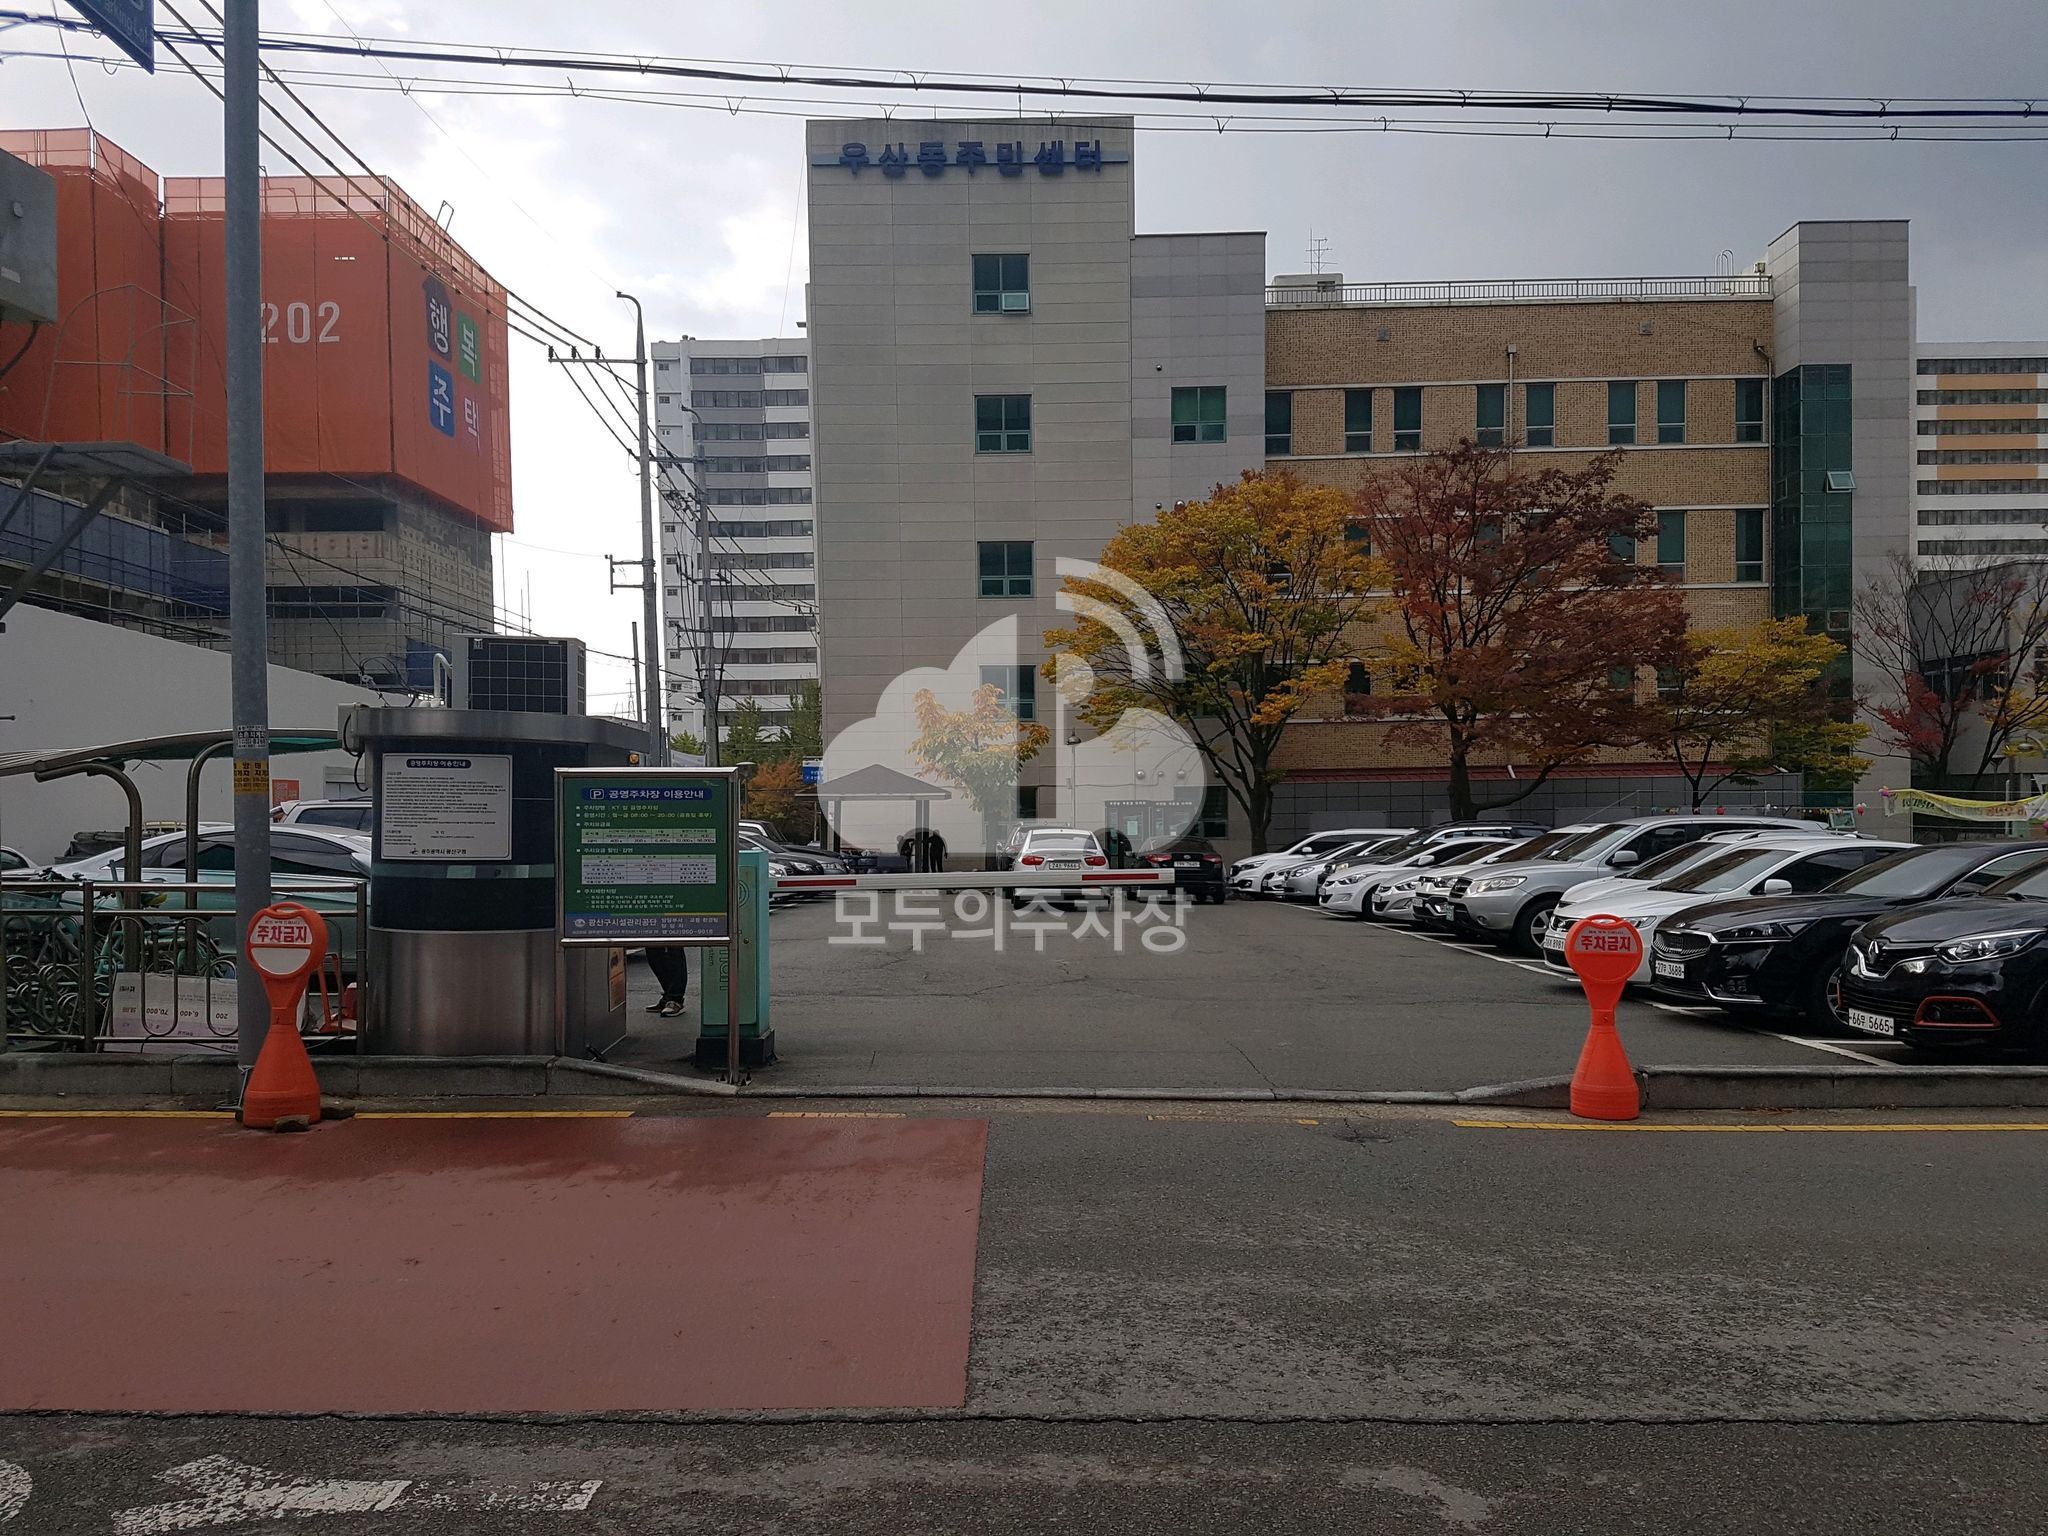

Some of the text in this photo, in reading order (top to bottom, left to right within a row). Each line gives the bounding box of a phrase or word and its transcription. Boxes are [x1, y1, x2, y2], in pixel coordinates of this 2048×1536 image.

[839, 140, 1101, 177] 우산동주민센터
[261, 302, 340, 344] 202
[609, 790, 660, 799] 공영주차장
[663, 790, 704, 799] 이용안내
[588, 918, 657, 927] 광산구시설관리공단
[257, 925, 307, 943] 주차금지
[1581, 935, 1631, 951] 주차금지
[215, 1012, 228, 1020] 200
[1868, 1015, 1890, 1033] 5665
